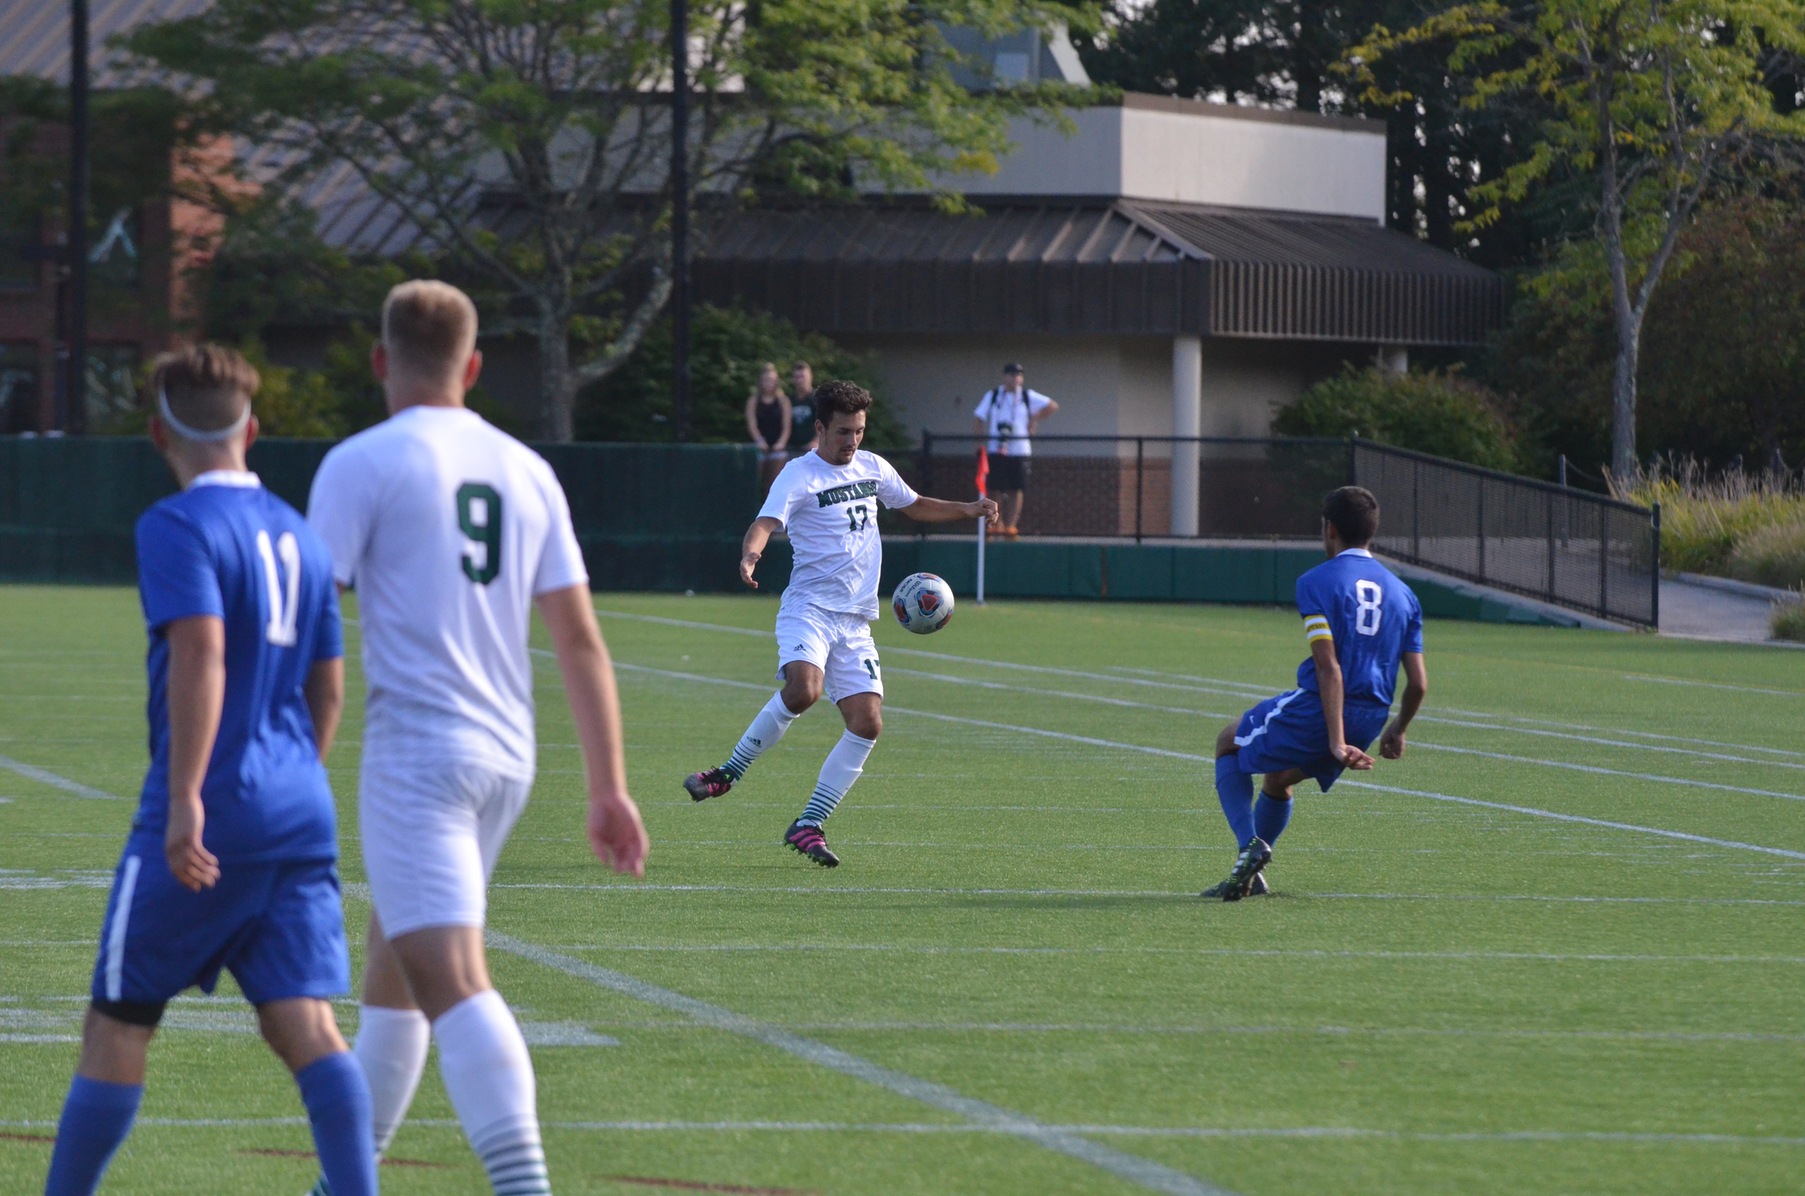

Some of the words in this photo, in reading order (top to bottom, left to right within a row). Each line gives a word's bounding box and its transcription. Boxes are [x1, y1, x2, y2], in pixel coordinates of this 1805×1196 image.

[456, 481, 503, 586] 9
[846, 504, 868, 532] 17
[257, 529, 300, 647] 11
[1355, 579, 1382, 636] 8
[864, 658, 880, 680] 1
